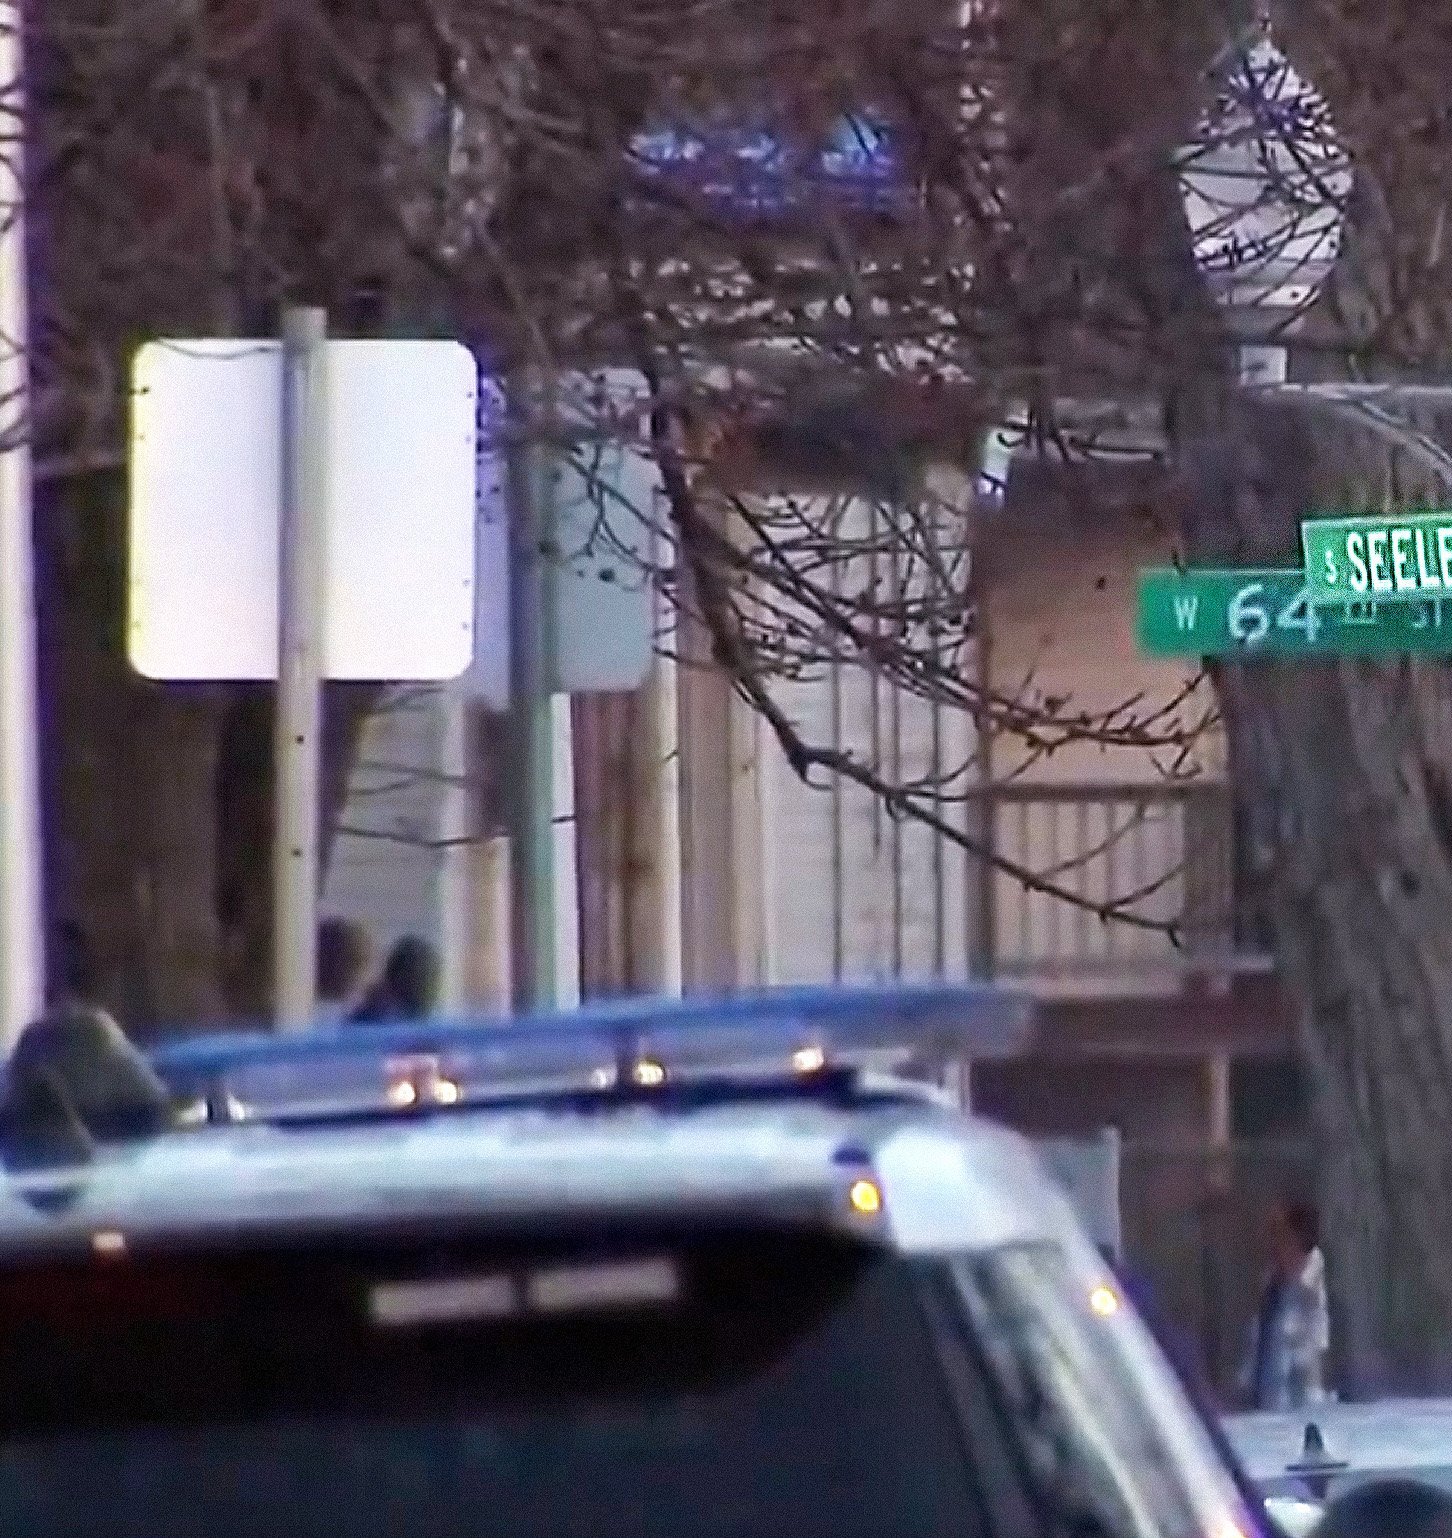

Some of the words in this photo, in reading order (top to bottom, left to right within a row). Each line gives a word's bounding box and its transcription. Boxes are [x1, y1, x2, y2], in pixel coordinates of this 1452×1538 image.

[1325, 551, 1337, 584] S
[1174, 596, 1199, 631] W
[1229, 583, 1321, 643] 64
